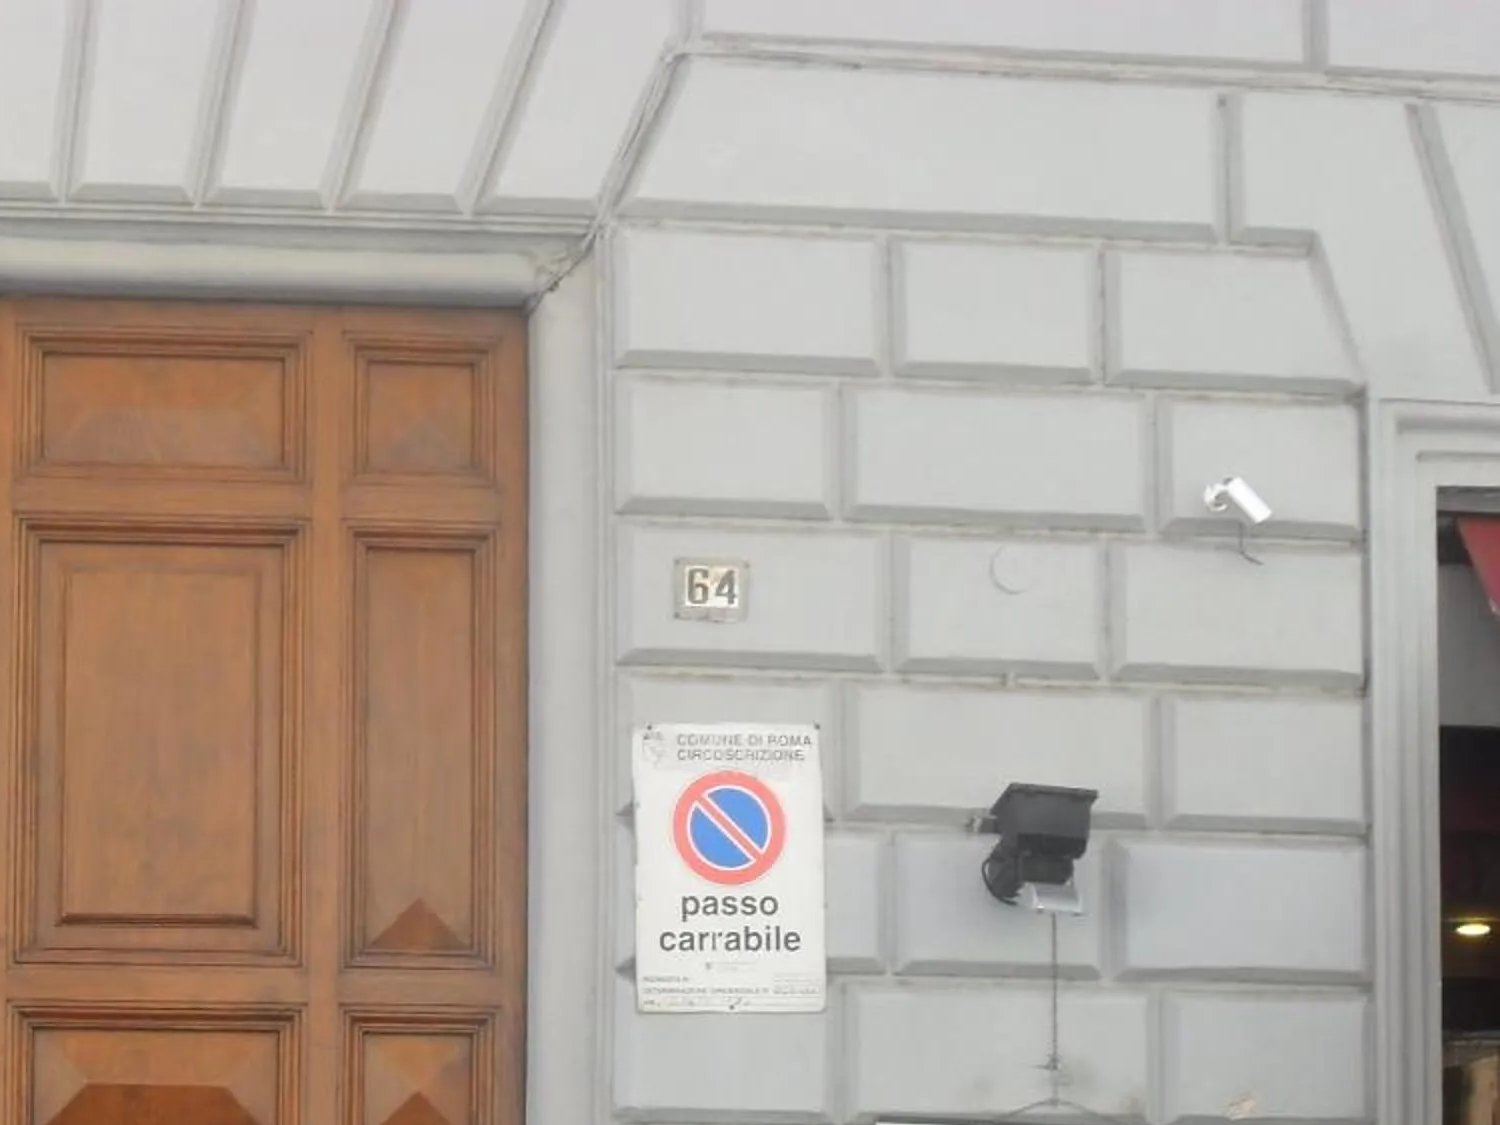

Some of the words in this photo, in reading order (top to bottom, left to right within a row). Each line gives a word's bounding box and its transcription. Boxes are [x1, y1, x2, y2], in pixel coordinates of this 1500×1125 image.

[687, 567, 737, 605] 64
[676, 733, 743, 747] COMUNE
[747, 733, 763, 747] DI
[767, 734, 812, 747] ROMA
[676, 748, 806, 762] CIRCOSCRIZIONE
[681, 895, 780, 923] passo
[659, 925, 802, 952] carrabile
